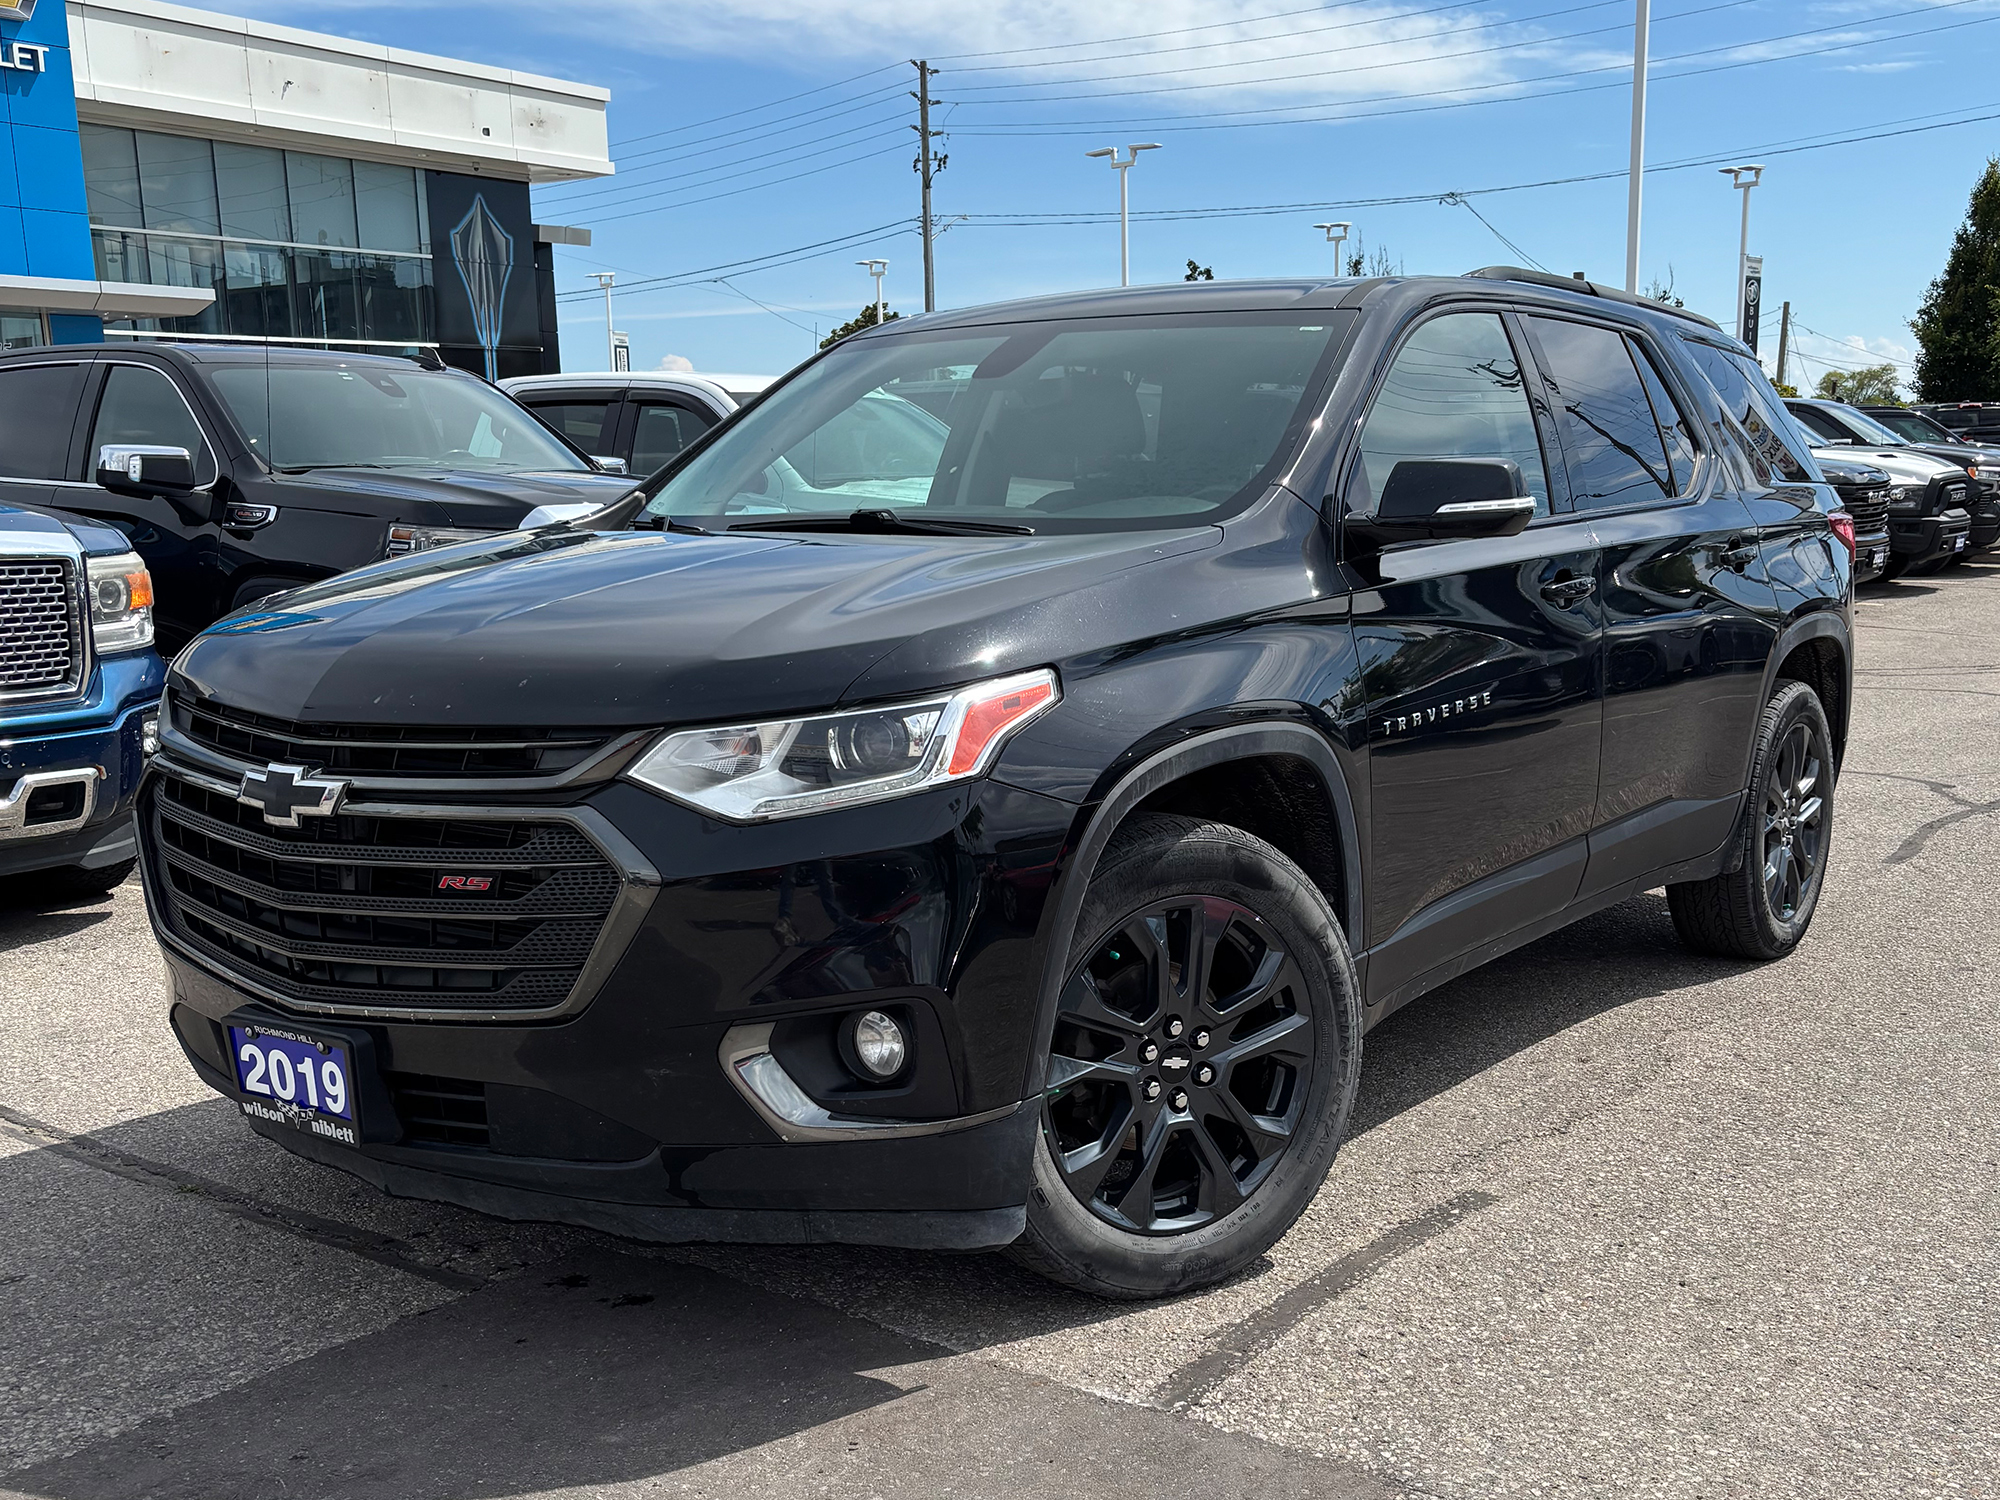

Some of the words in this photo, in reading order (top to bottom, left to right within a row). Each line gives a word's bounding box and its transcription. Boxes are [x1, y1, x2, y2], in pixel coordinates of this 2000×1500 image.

[1383, 691, 1491, 735] TRAVERSE
[438, 876, 493, 890] RS
[253, 1025, 296, 1041] RICHMOND
[297, 1033, 315, 1045] HILL
[240, 1043, 346, 1114] 2019
[242, 1101, 286, 1124] wilson
[311, 1119, 355, 1144] niblett
